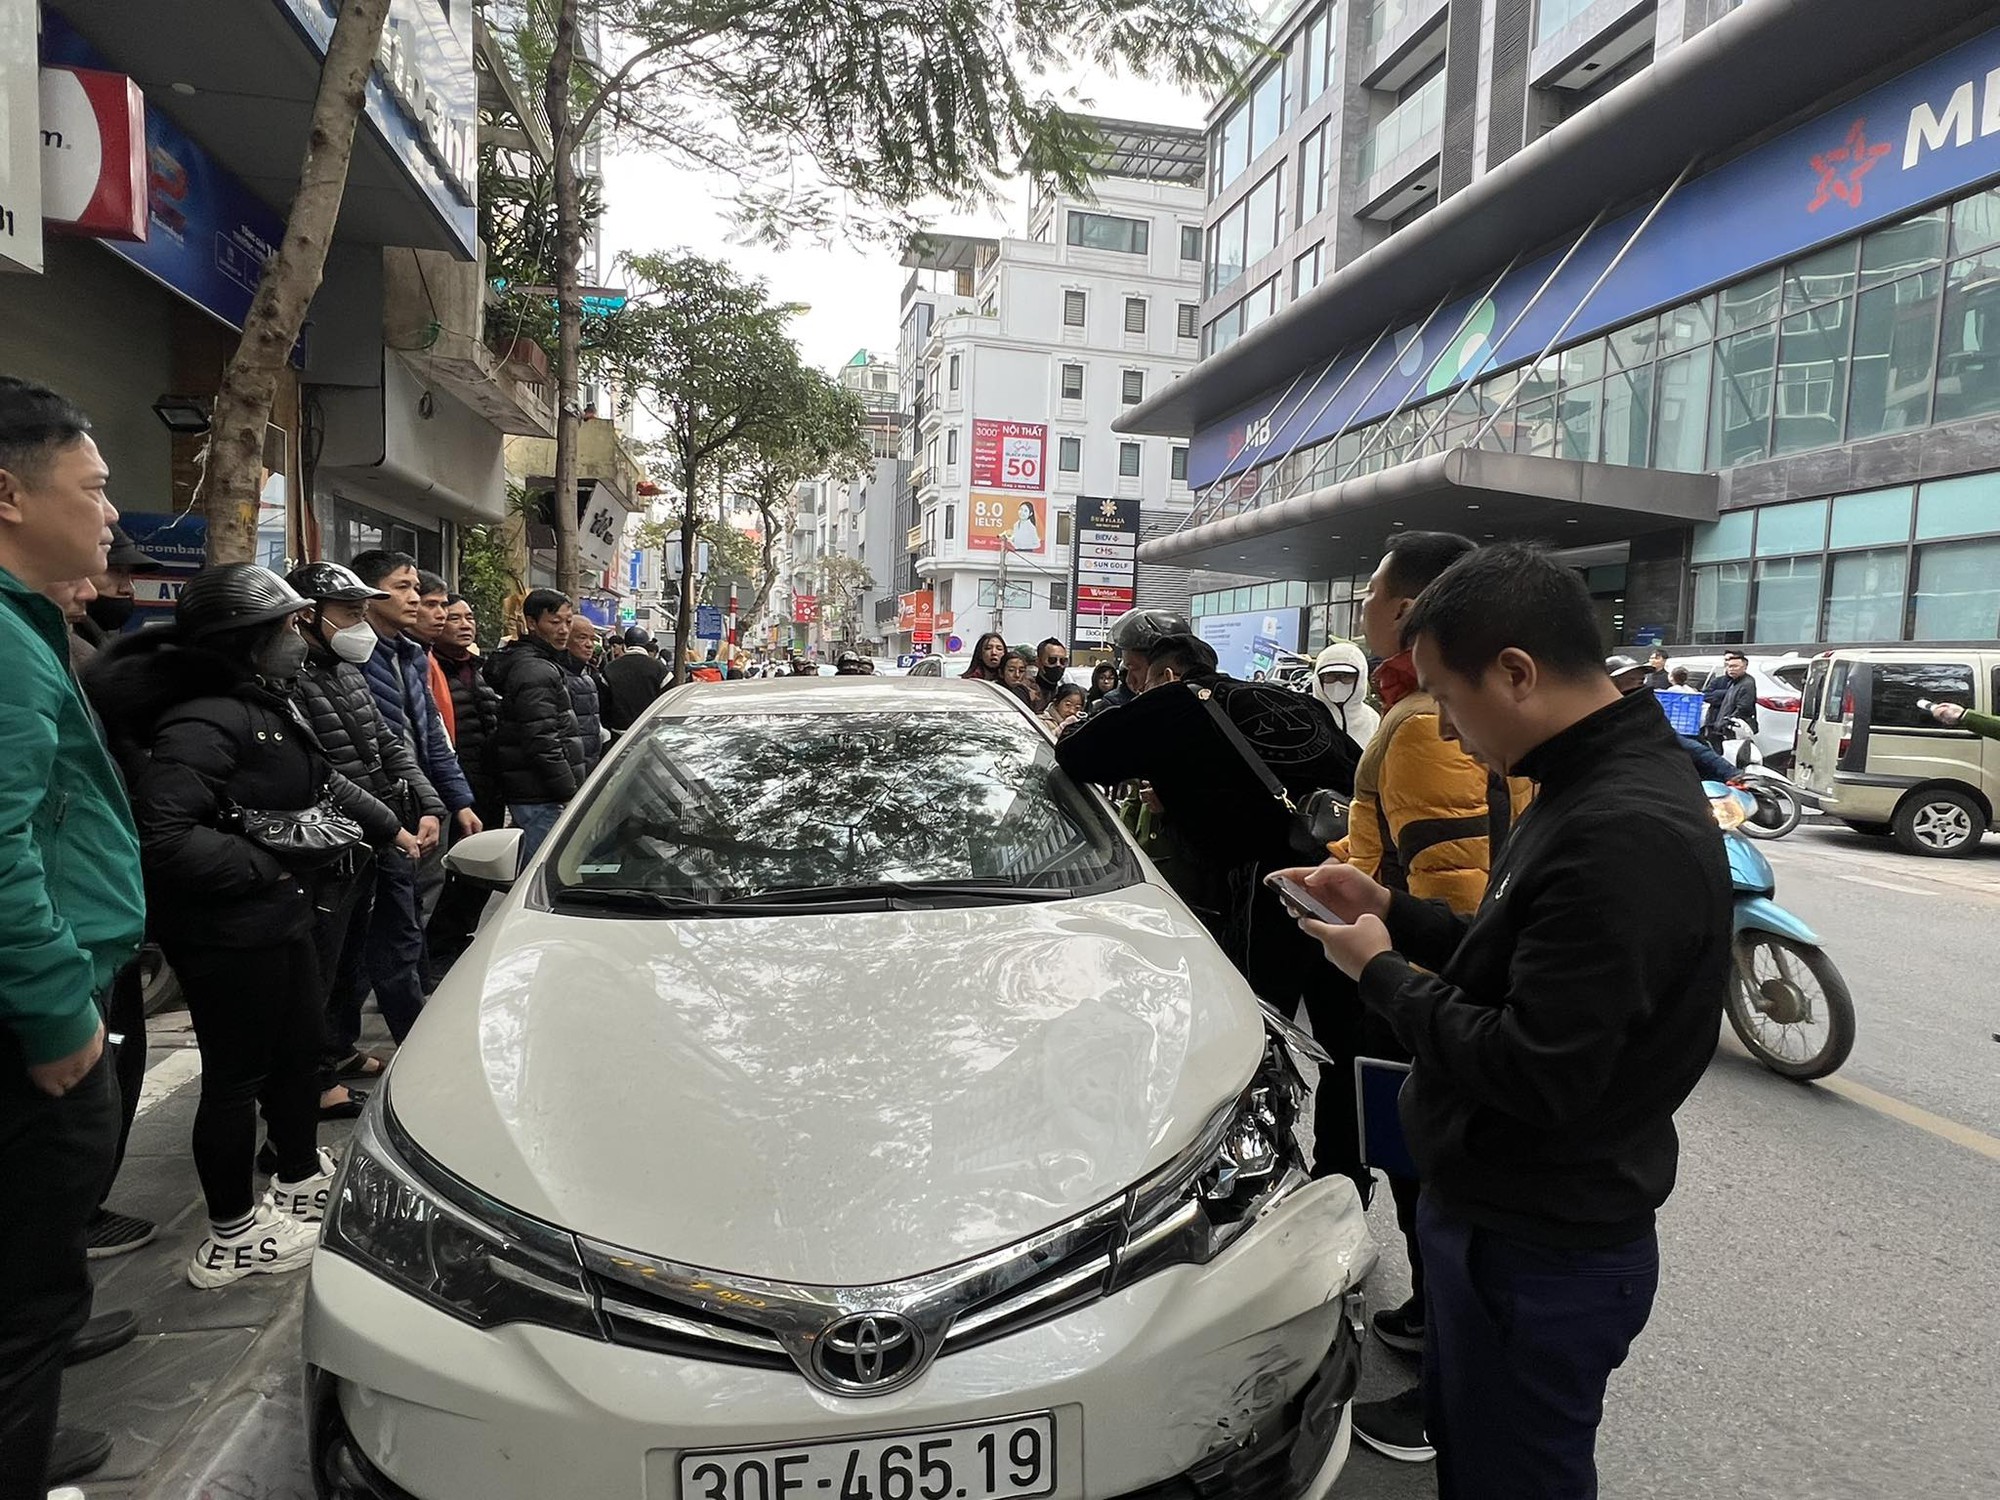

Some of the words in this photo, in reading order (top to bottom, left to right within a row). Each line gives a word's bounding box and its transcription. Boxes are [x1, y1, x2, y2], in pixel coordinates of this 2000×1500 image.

[1003, 423, 1019, 436] NỘI
[1022, 425, 1043, 437] THẤT
[1007, 458, 1036, 478] 50
[975, 501, 1003, 517] 8.0
[975, 517, 1003, 528] IELTS
[1095, 533, 1112, 541] BIDV
[136, 541, 205, 555] acomban
[1093, 560, 1109, 568] SUN
[1110, 561, 1128, 569] GOLF
[158, 583, 186, 600] AT
[1090, 588, 1118, 597] WinMart
